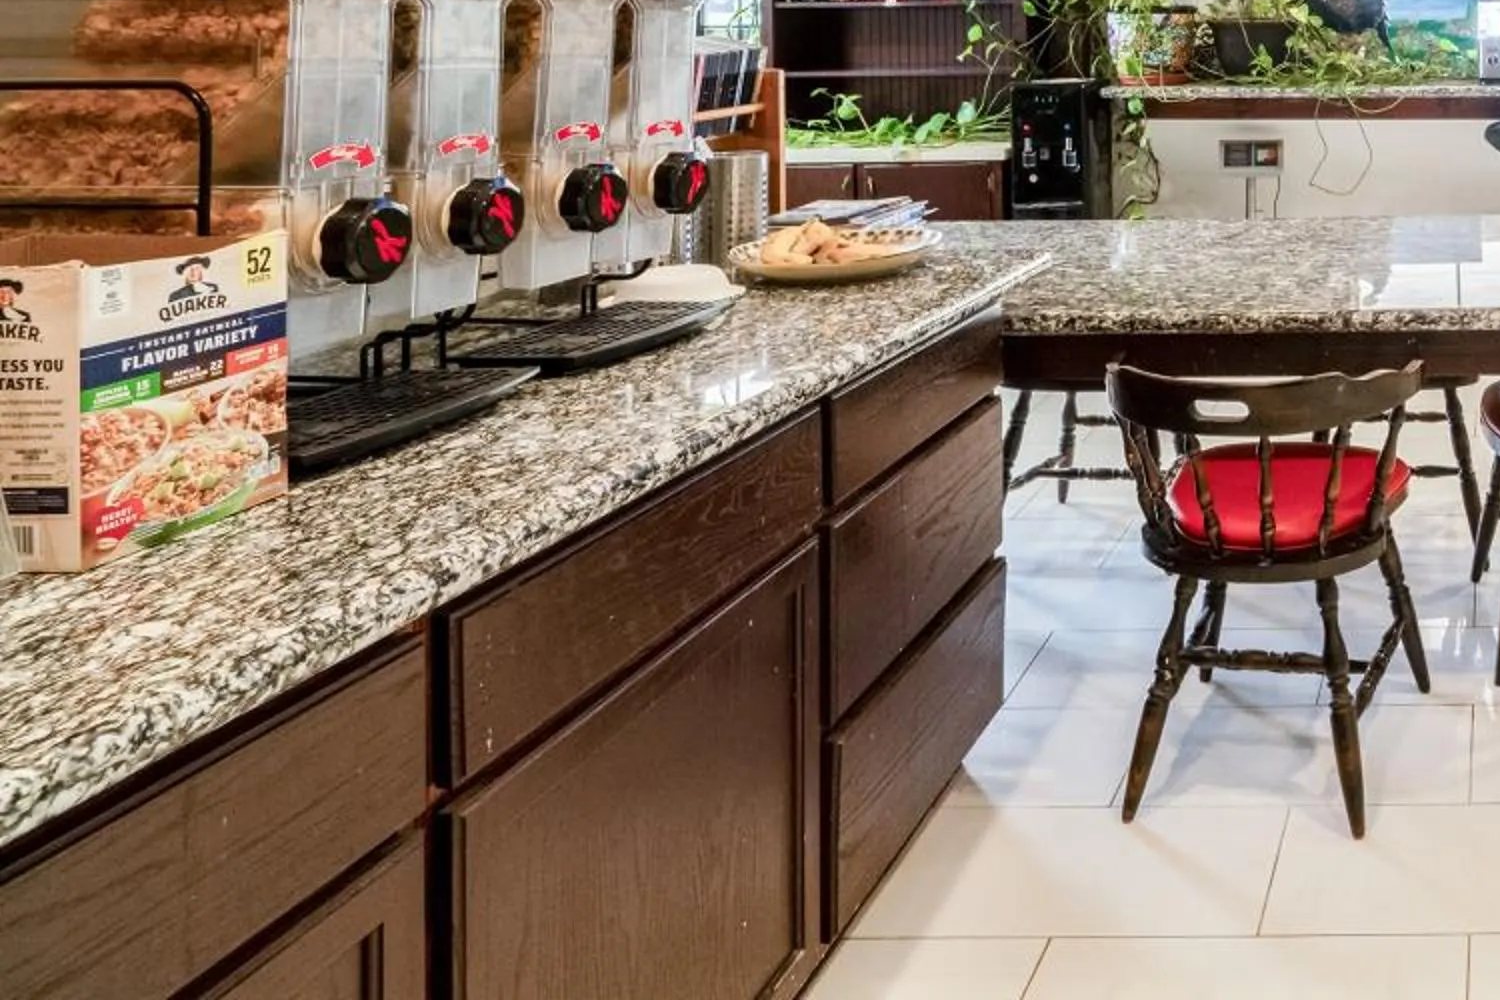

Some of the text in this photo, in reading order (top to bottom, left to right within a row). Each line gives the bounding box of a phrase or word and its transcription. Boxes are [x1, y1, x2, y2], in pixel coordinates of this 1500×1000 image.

[247, 246, 271, 275] 52
[158, 295, 228, 323] QUAKER
[120, 325, 259, 373] FLAVOR VARIETY
[33, 359, 64, 373] YOU
